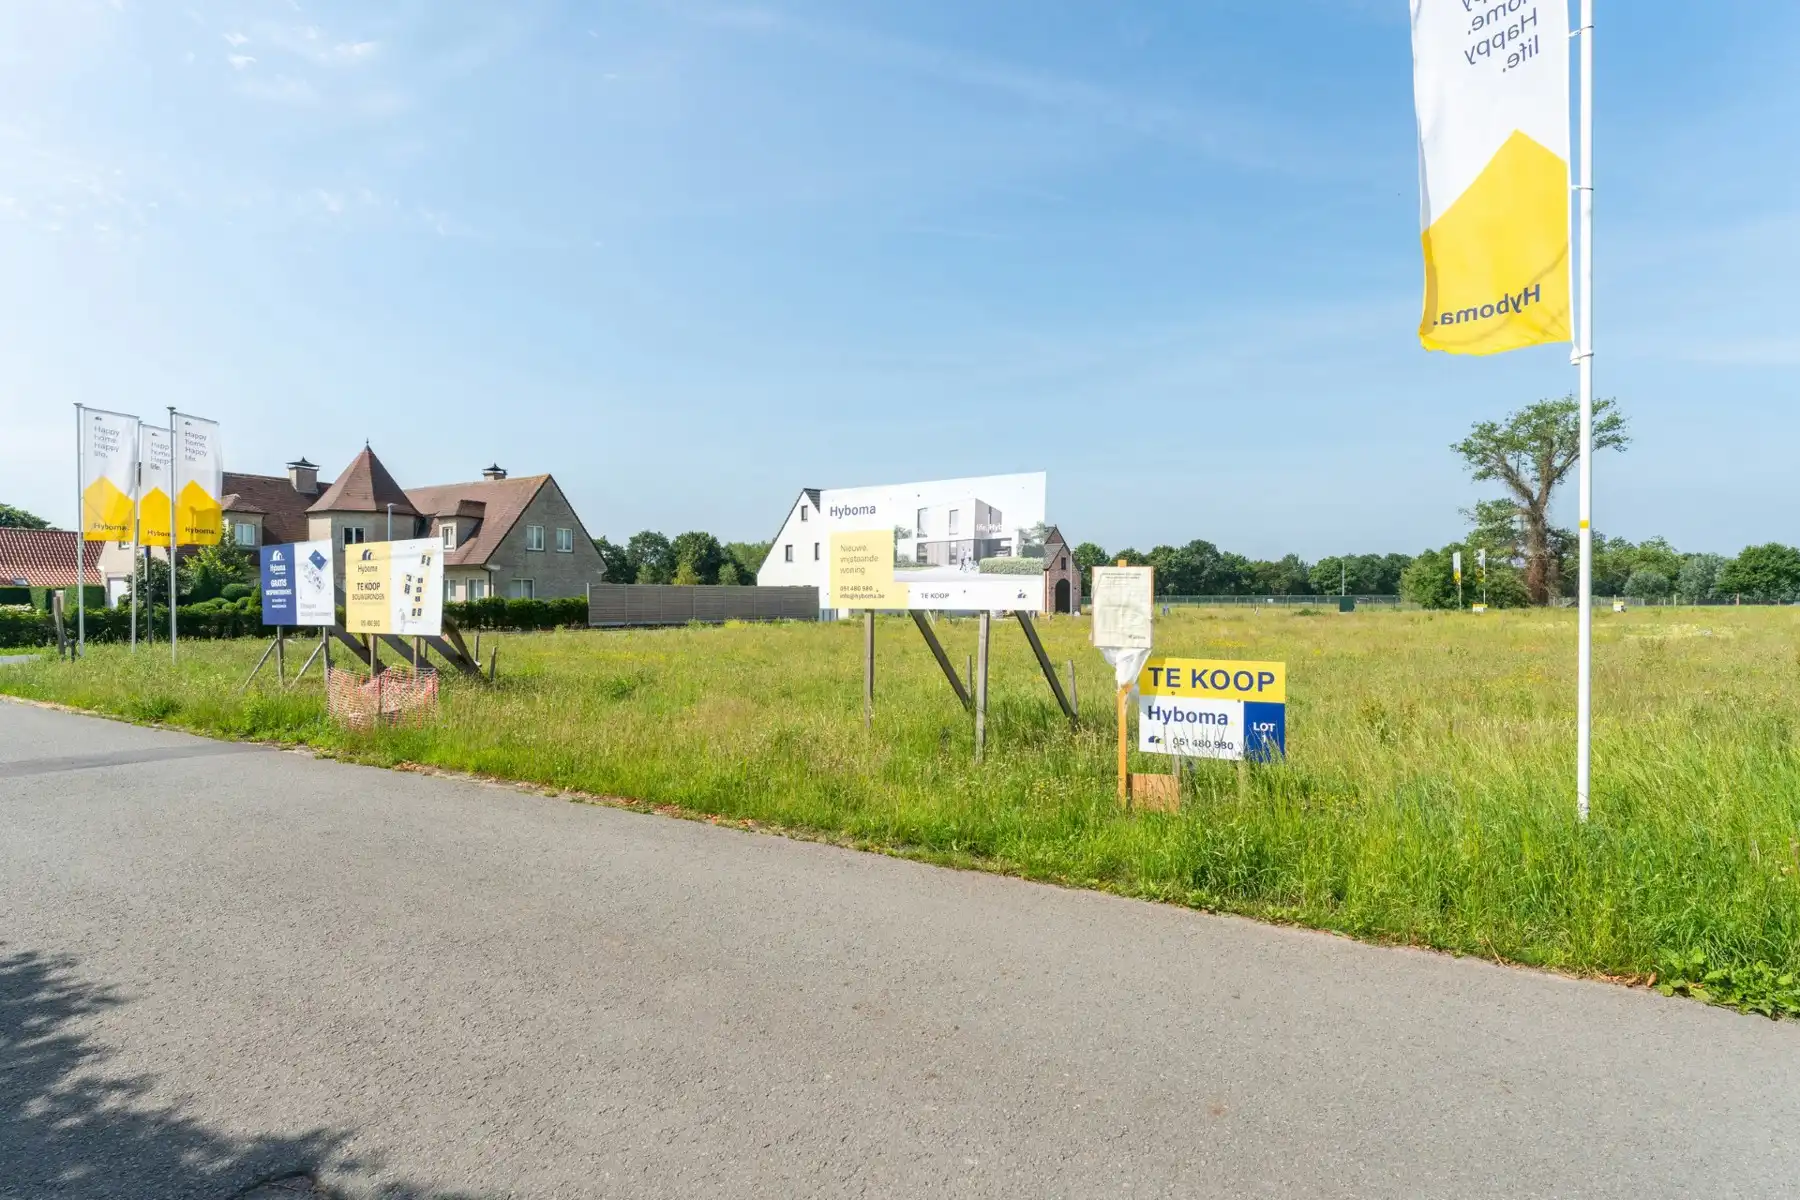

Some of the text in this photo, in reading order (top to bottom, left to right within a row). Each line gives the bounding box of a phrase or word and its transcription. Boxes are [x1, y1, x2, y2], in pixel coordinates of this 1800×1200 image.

[94, 425, 120, 437] Happy
[184, 430, 207, 441] Happy
[94, 441, 120, 453] Happy
[151, 440, 170, 450] Happ
[184, 446, 207, 457] Happy
[151, 455, 170, 465] Happ
[356, 582, 381, 591] TE KOOP
[1148, 667, 1275, 693] TE KOOP
[1253, 721, 1276, 732] LOT
[1192, 739, 1211, 749] 480
